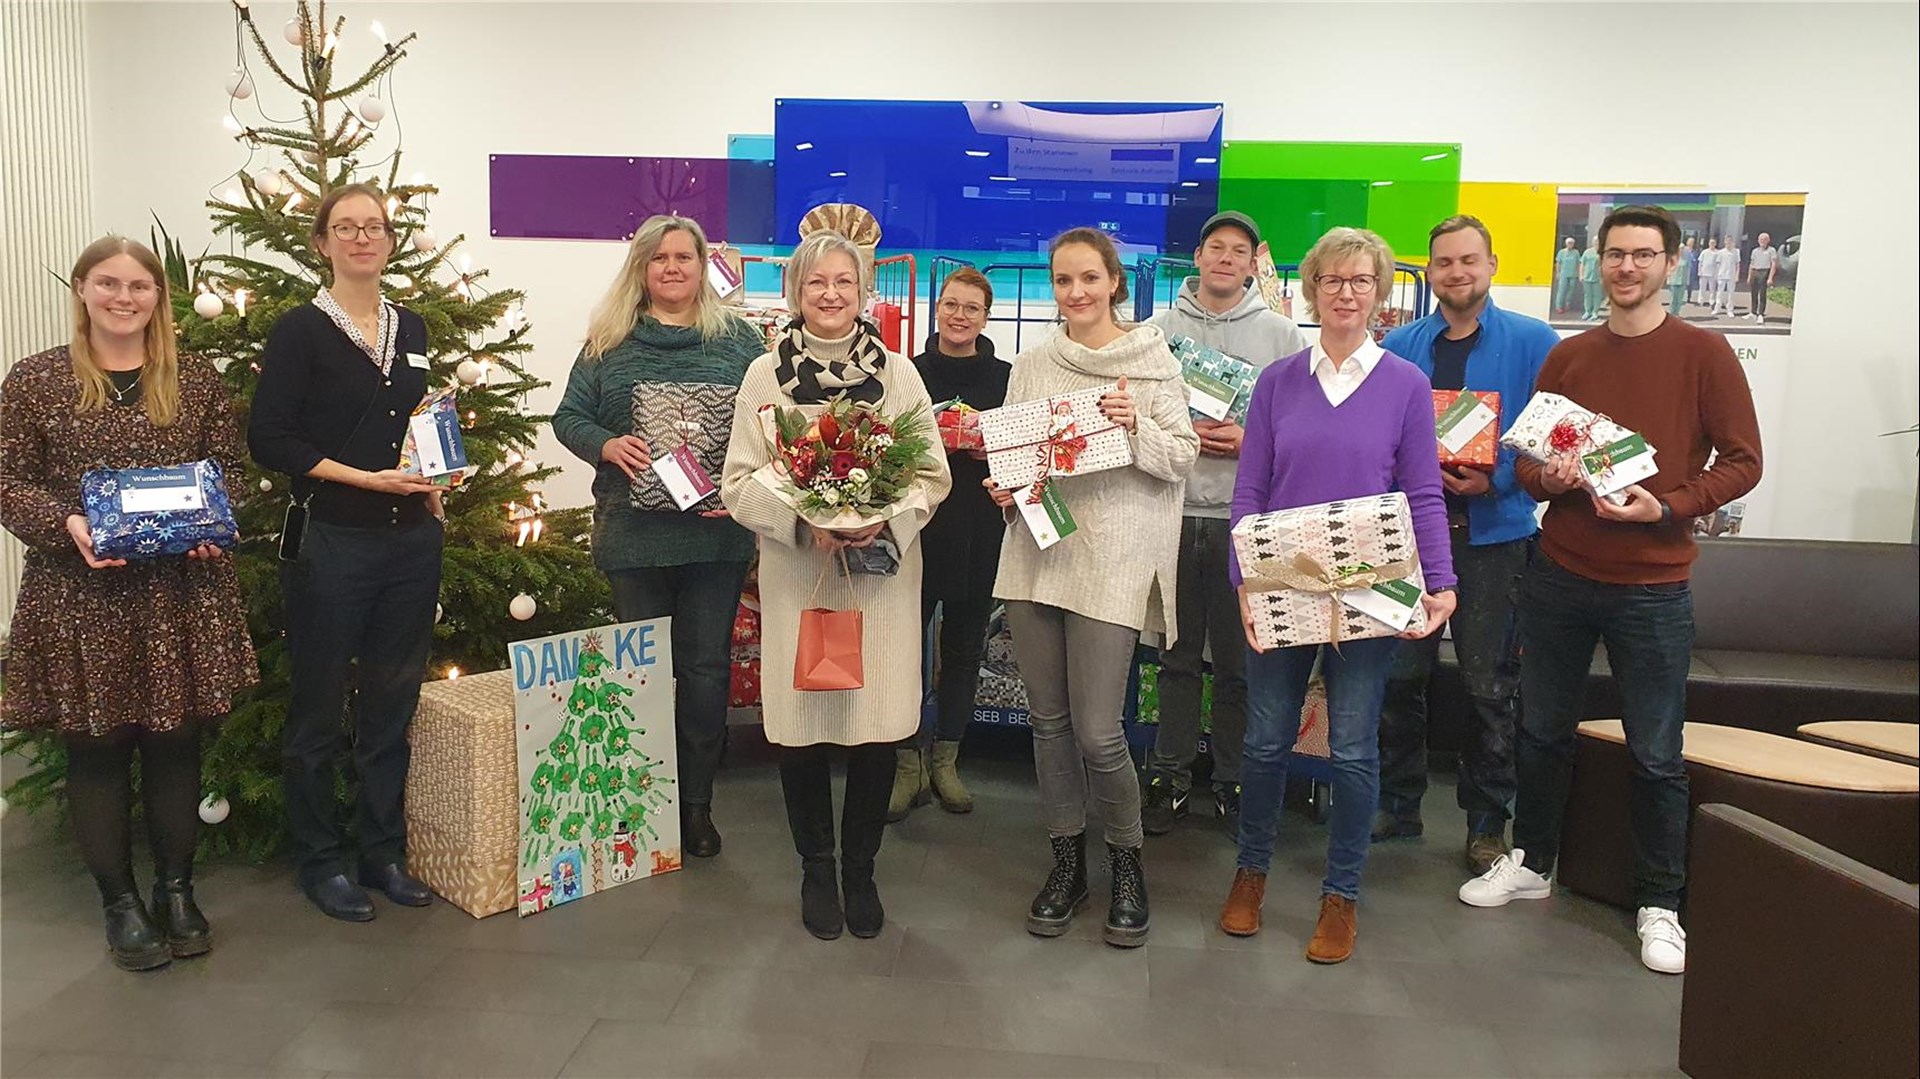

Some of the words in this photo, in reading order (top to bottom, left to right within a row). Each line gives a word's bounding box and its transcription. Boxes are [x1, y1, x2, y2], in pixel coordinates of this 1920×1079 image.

[1736, 348, 1758, 360] EN
[444, 419, 458, 462] Wunschbaum
[132, 473, 186, 482] Wunschbaum
[973, 709, 1000, 723] SEB
